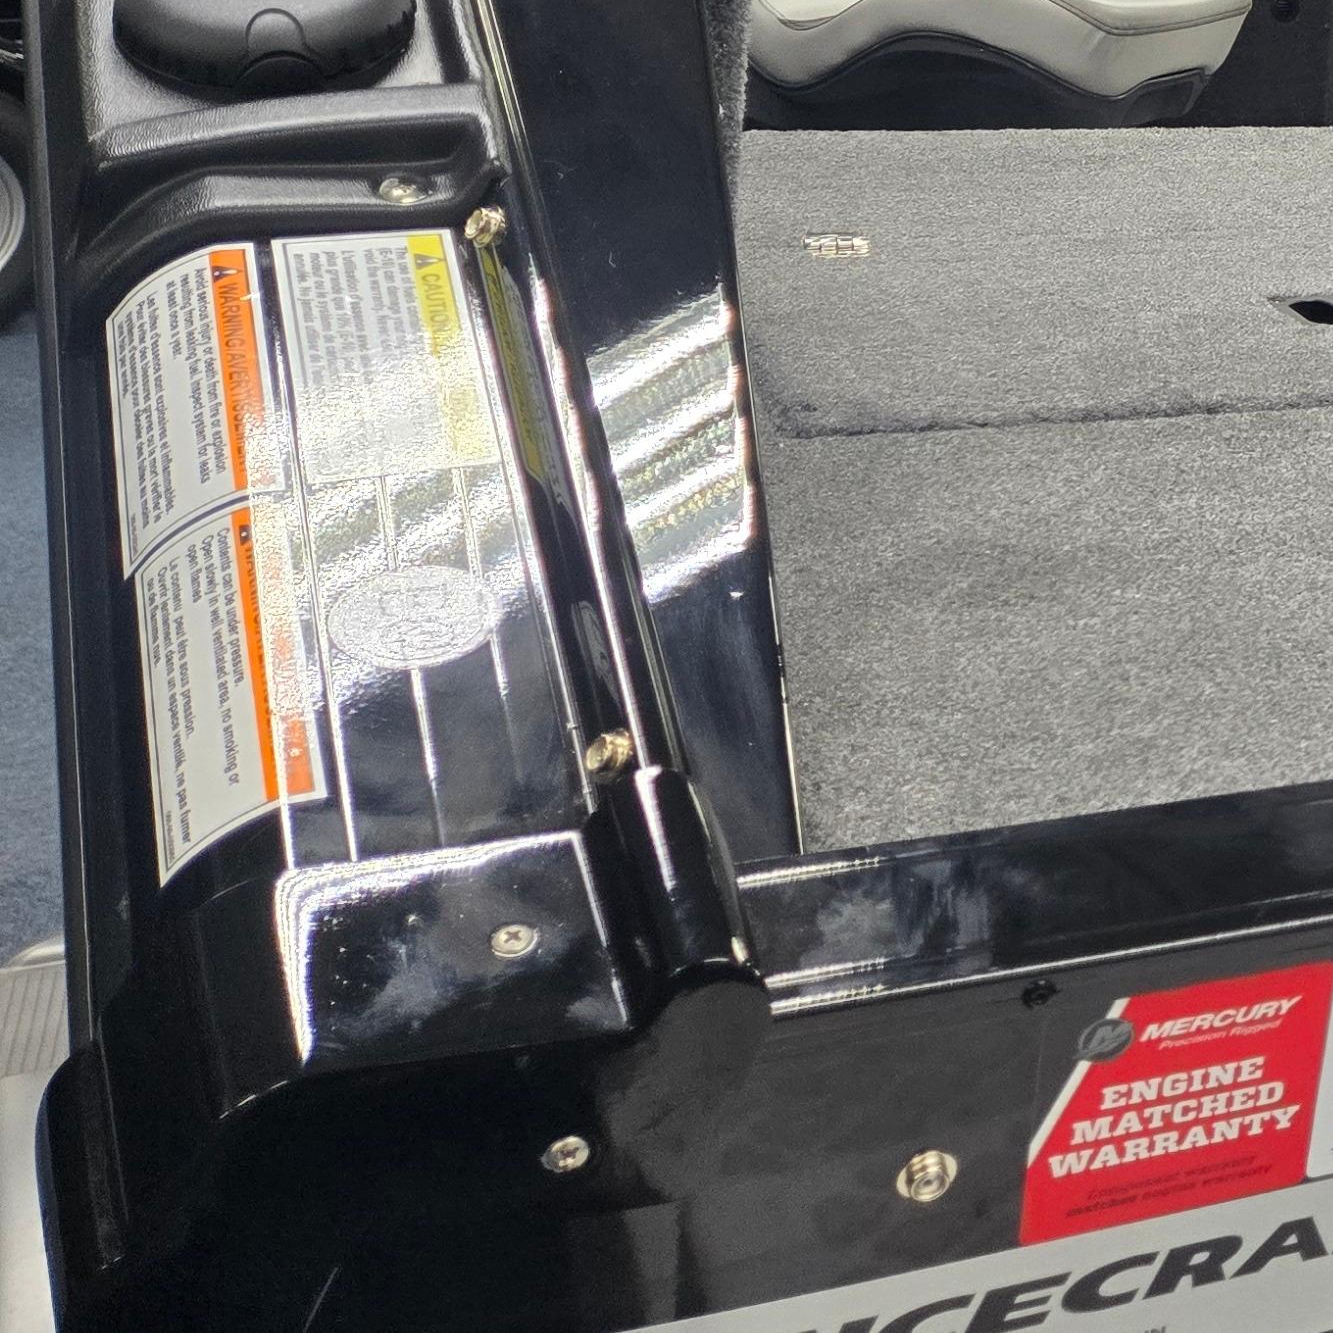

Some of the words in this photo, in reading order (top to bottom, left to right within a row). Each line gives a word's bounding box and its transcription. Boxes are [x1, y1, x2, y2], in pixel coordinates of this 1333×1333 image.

[194, 268, 208, 290] Avoid
[203, 347, 213, 356] or
[211, 419, 221, 429] or
[211, 431, 228, 474] explosion
[199, 459, 212, 484] leaks
[185, 544, 199, 570] open
[200, 535, 215, 565] Open
[217, 527, 233, 572] Contents
[190, 568, 203, 604] flames
[204, 563, 220, 596] slowly
[222, 573, 233, 592] can
[208, 595, 221, 607] in
[224, 590, 238, 606] be
[210, 607, 224, 630] well
[226, 607, 240, 636] under
[212, 629, 230, 680] ventilated
[227, 638, 245, 687] pressure.
[218, 681, 230, 708] area,
[221, 708, 233, 723] no
[222, 725, 239, 774] smoking
[229, 774, 241, 786] or
[1139, 995, 1302, 1042] MERCURY
[1158, 1032, 1226, 1050] Precision
[1228, 1019, 1281, 1038] Rigged
[1100, 1056, 1266, 1110] ENGINE
[1070, 1081, 1285, 1145] MATCHED
[1047, 1104, 1302, 1179] WARRANTY
